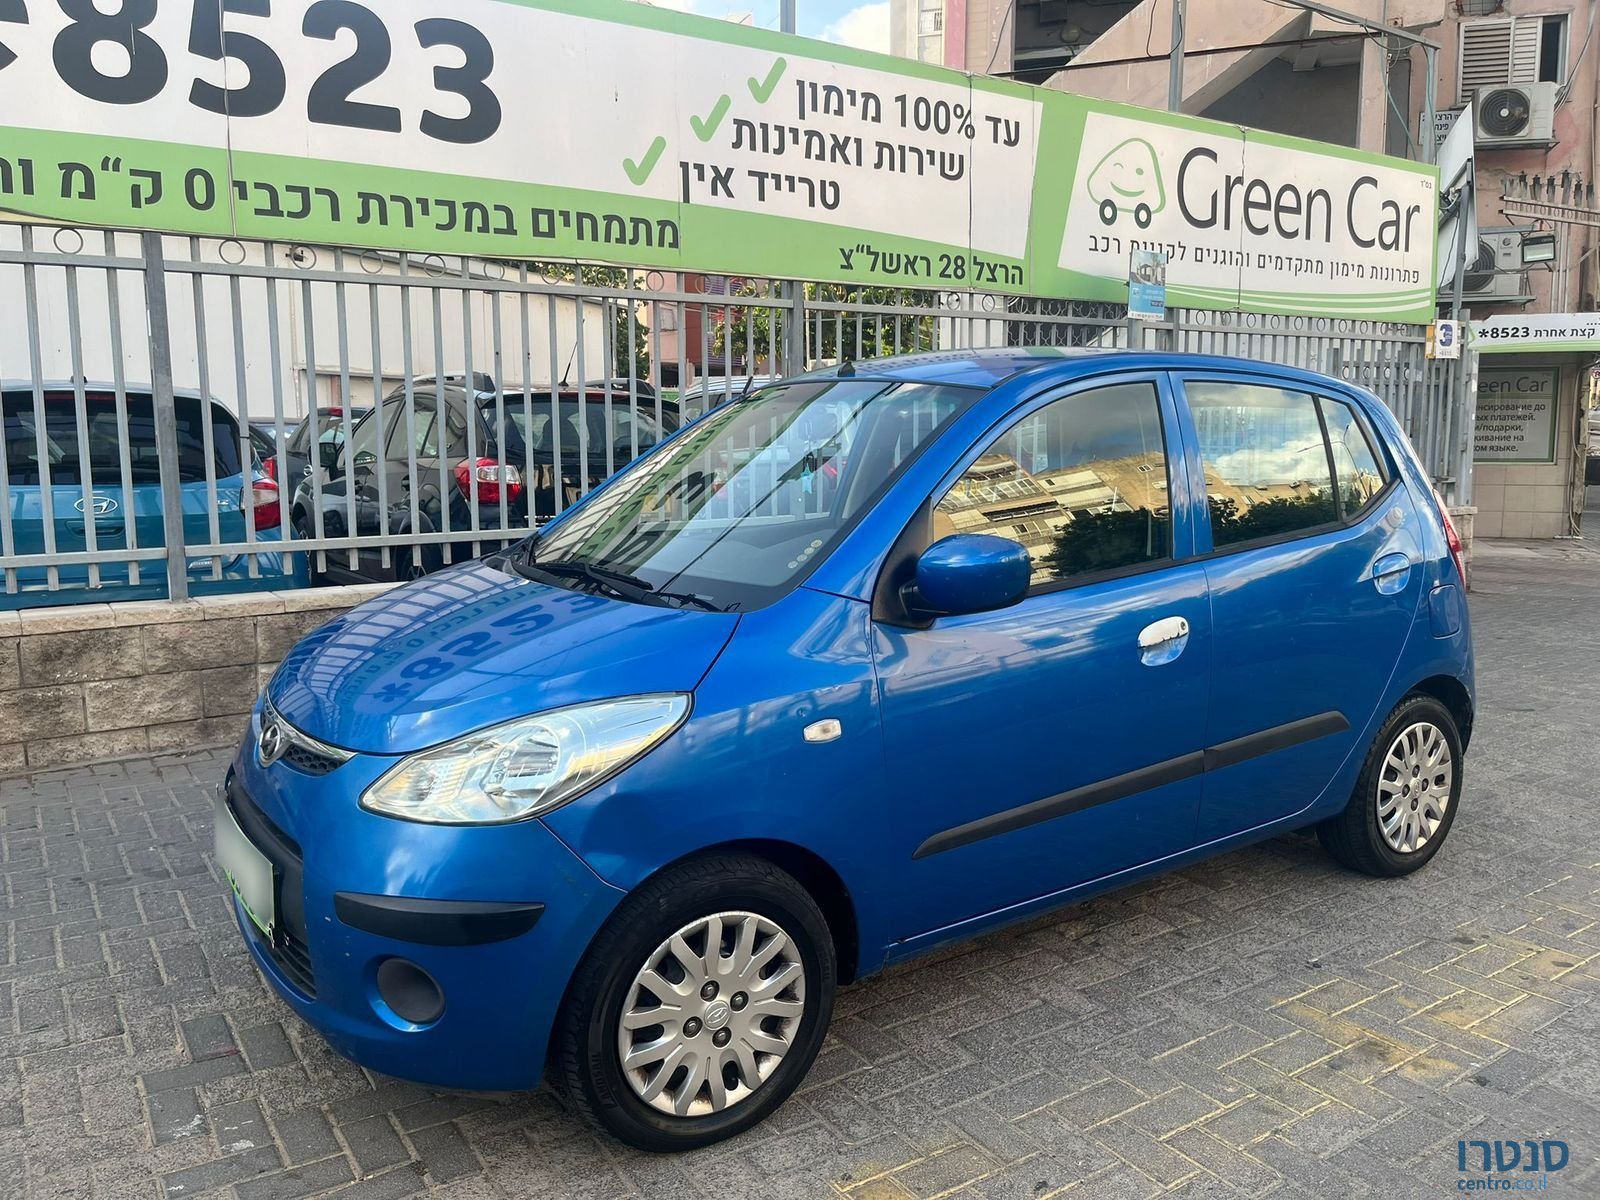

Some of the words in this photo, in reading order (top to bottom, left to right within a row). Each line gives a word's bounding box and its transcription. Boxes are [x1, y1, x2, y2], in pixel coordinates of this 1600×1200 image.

[795, 79, 882, 123] מימון
[894, 96, 976, 139] 100%
[985, 114, 1021, 147] עד
[731, 116, 863, 167] ואמינות
[874, 140, 965, 181] שירות
[184, 167, 216, 211] 0
[679, 160, 735, 204] אין
[747, 169, 841, 211] טרייד
[231, 179, 341, 222] רכבי
[356, 191, 518, 236] במכירת
[1176, 146, 1332, 243] Green
[1346, 175, 1421, 253] Car
[531, 207, 679, 249] מתמחים
[1088, 234, 1121, 254] רכב
[938, 252, 966, 280] 28
[973, 255, 1024, 286] הרצל
[1194, 247, 1250, 268] והוגנים
[1257, 254, 1324, 277] מתקדמים
[1330, 261, 1365, 280] מימון
[1369, 264, 1420, 284] פתרונות
[1533, 328, 1567, 338] אחרת
[1569, 327, 1596, 339] קצת
[1516, 376, 1548, 393] Car
[1490, 412, 1536, 421] платежей.
[1533, 403, 1546, 412] до
